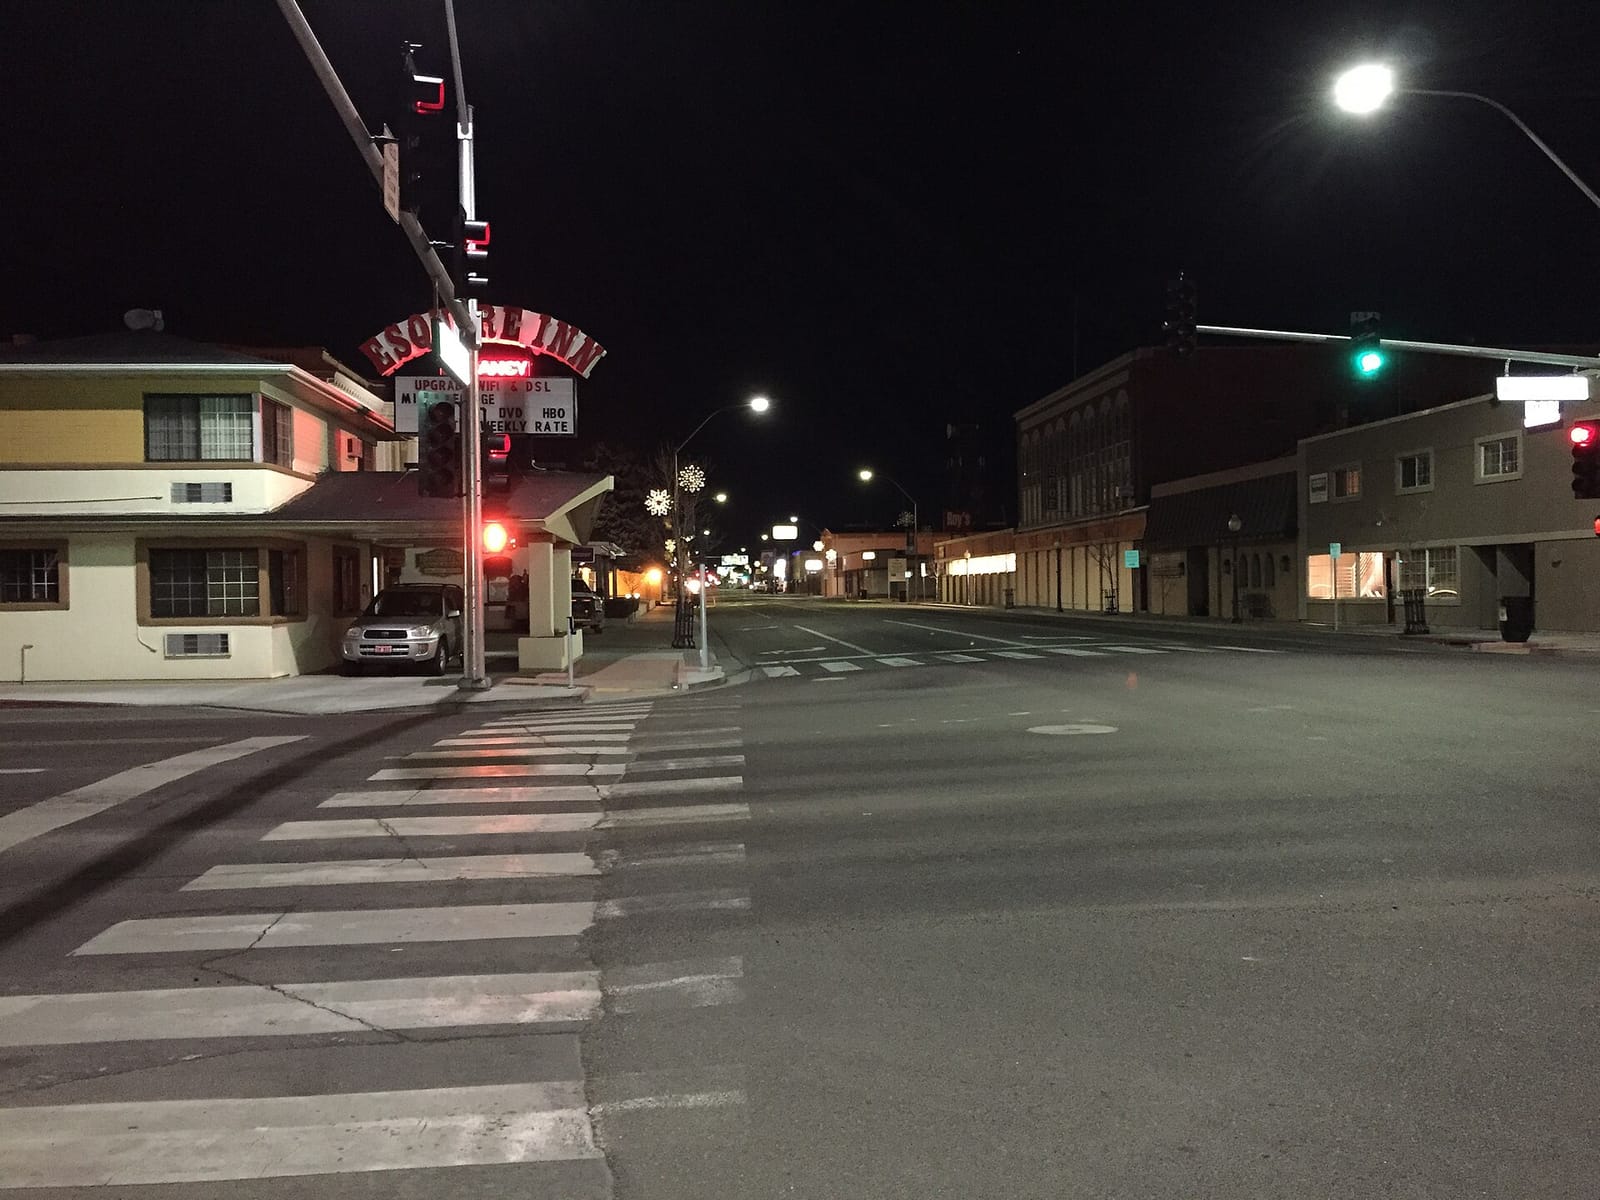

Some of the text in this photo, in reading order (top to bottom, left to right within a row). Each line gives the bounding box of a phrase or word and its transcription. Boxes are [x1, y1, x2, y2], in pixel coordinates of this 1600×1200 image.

[358, 304, 605, 376] ESQRE INN
[415, 380, 463, 391] UPGRAD
[526, 382, 551, 392] DSL
[499, 407, 566, 419] DVD HBO
[480, 420, 568, 432] WEEKLY RATE
[946, 511, 971, 528] Roy's
